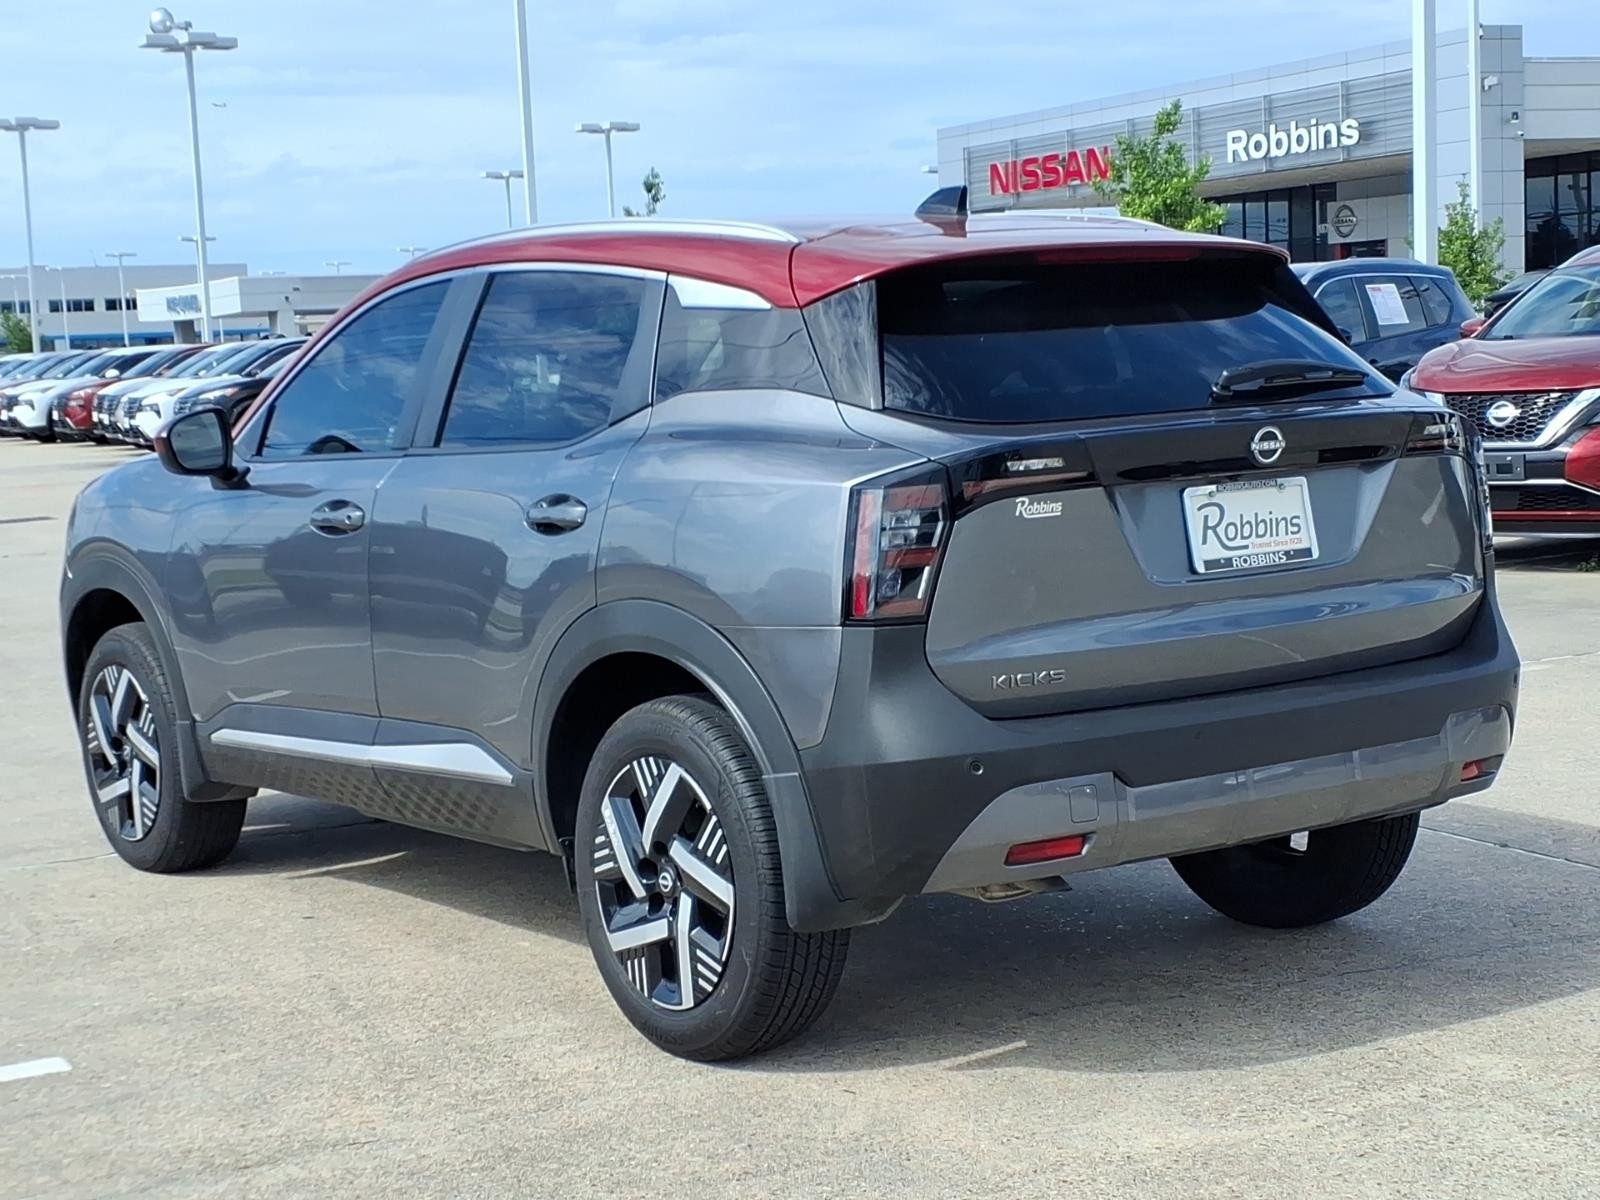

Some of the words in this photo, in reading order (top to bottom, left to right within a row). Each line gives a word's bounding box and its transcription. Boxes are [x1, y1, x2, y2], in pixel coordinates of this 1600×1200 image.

[1226, 118, 1360, 163] Robbins
[989, 146, 1111, 196] NISSAN
[1251, 440, 1285, 450] NISSAN
[1015, 497, 1062, 518] Robbins
[1197, 502, 1302, 551] Robbins
[1232, 551, 1287, 568] ROBBINS
[992, 669, 1065, 689] KICKS
